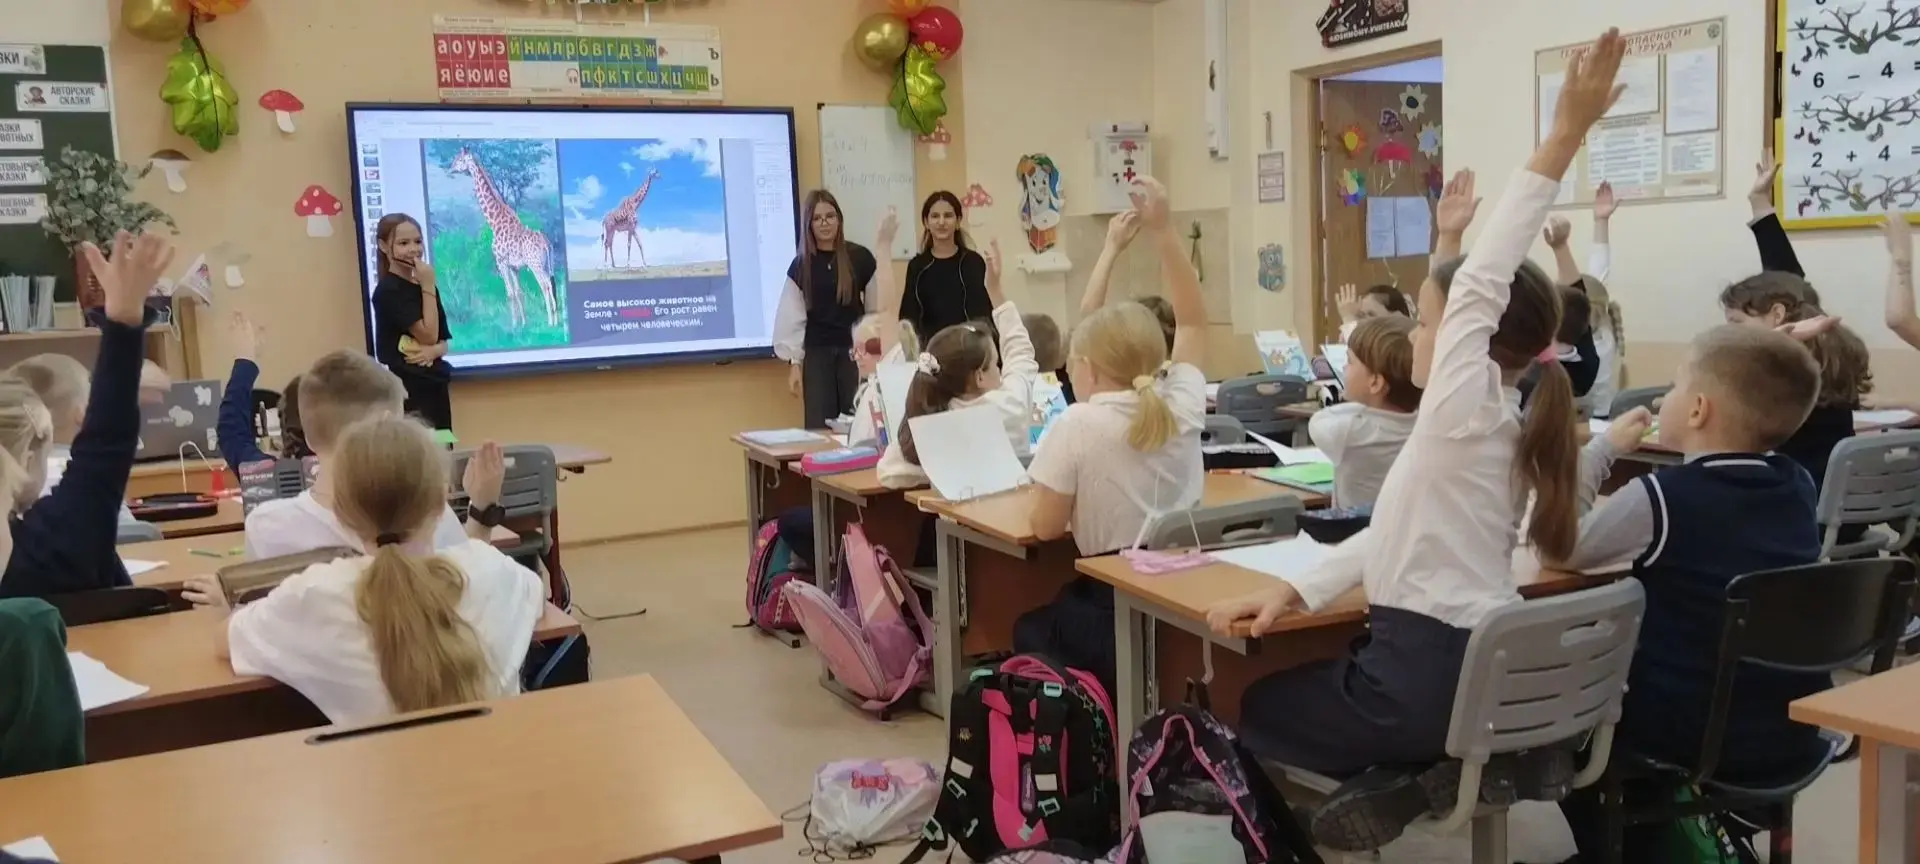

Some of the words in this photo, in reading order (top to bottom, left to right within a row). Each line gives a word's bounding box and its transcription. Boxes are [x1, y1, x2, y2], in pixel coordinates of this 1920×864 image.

[1813, 72, 1824, 88] 6
[1881, 61, 1893, 78] 4
[50, 85, 96, 96] АВТОРСКИЕ
[59, 96, 91, 105] СКАЗКИ
[1811, 152, 1823, 168] 2
[1878, 145, 1890, 161] 4
[584, 300, 614, 308] Самое
[617, 299, 656, 307] высокое
[659, 296, 704, 305] животное
[584, 310, 612, 319] Земле
[654, 306, 669, 315] Его
[671, 306, 690, 315] рост
[692, 304, 717, 315] равен
[600, 322, 639, 332] четырем
